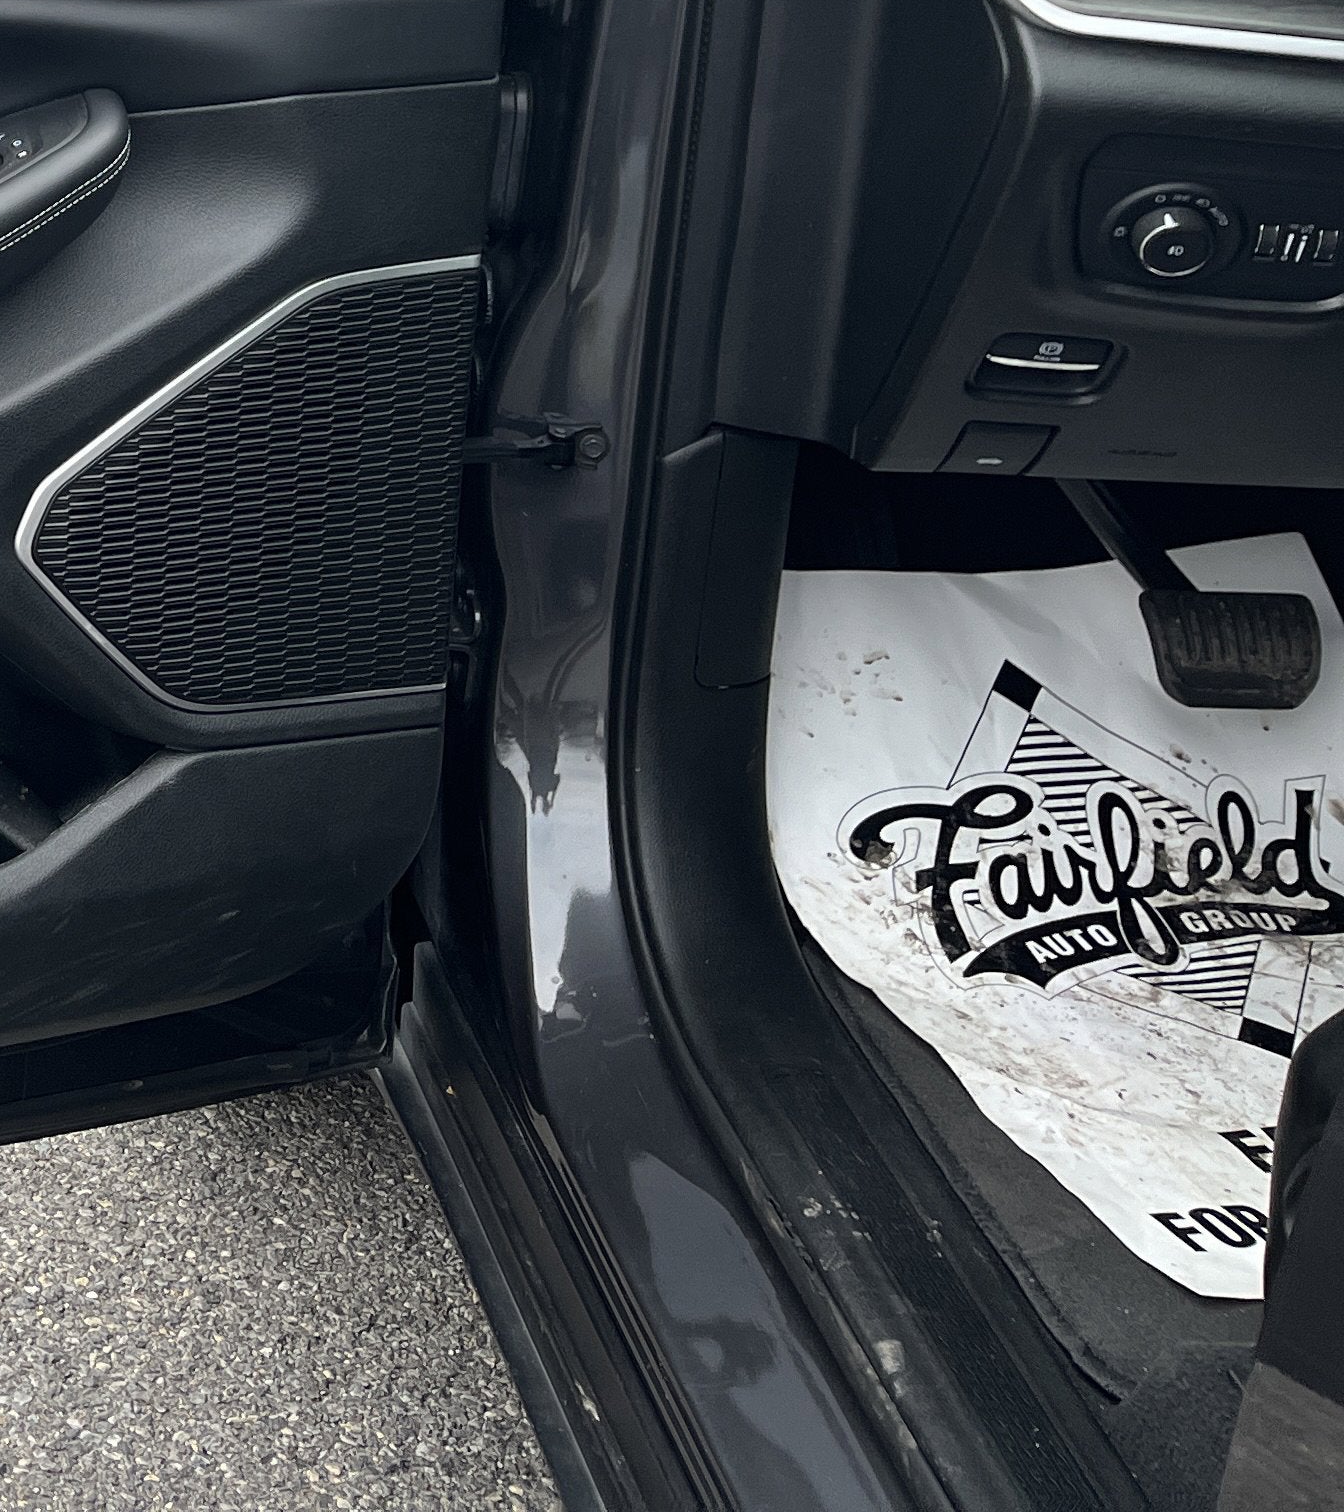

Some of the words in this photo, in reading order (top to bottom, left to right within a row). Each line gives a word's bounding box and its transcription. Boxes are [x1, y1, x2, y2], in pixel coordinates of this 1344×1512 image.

[849, 784, 1324, 967] Fairfield
[1025, 925, 1118, 965] AUTO
[1179, 911, 1299, 935] GROUP
